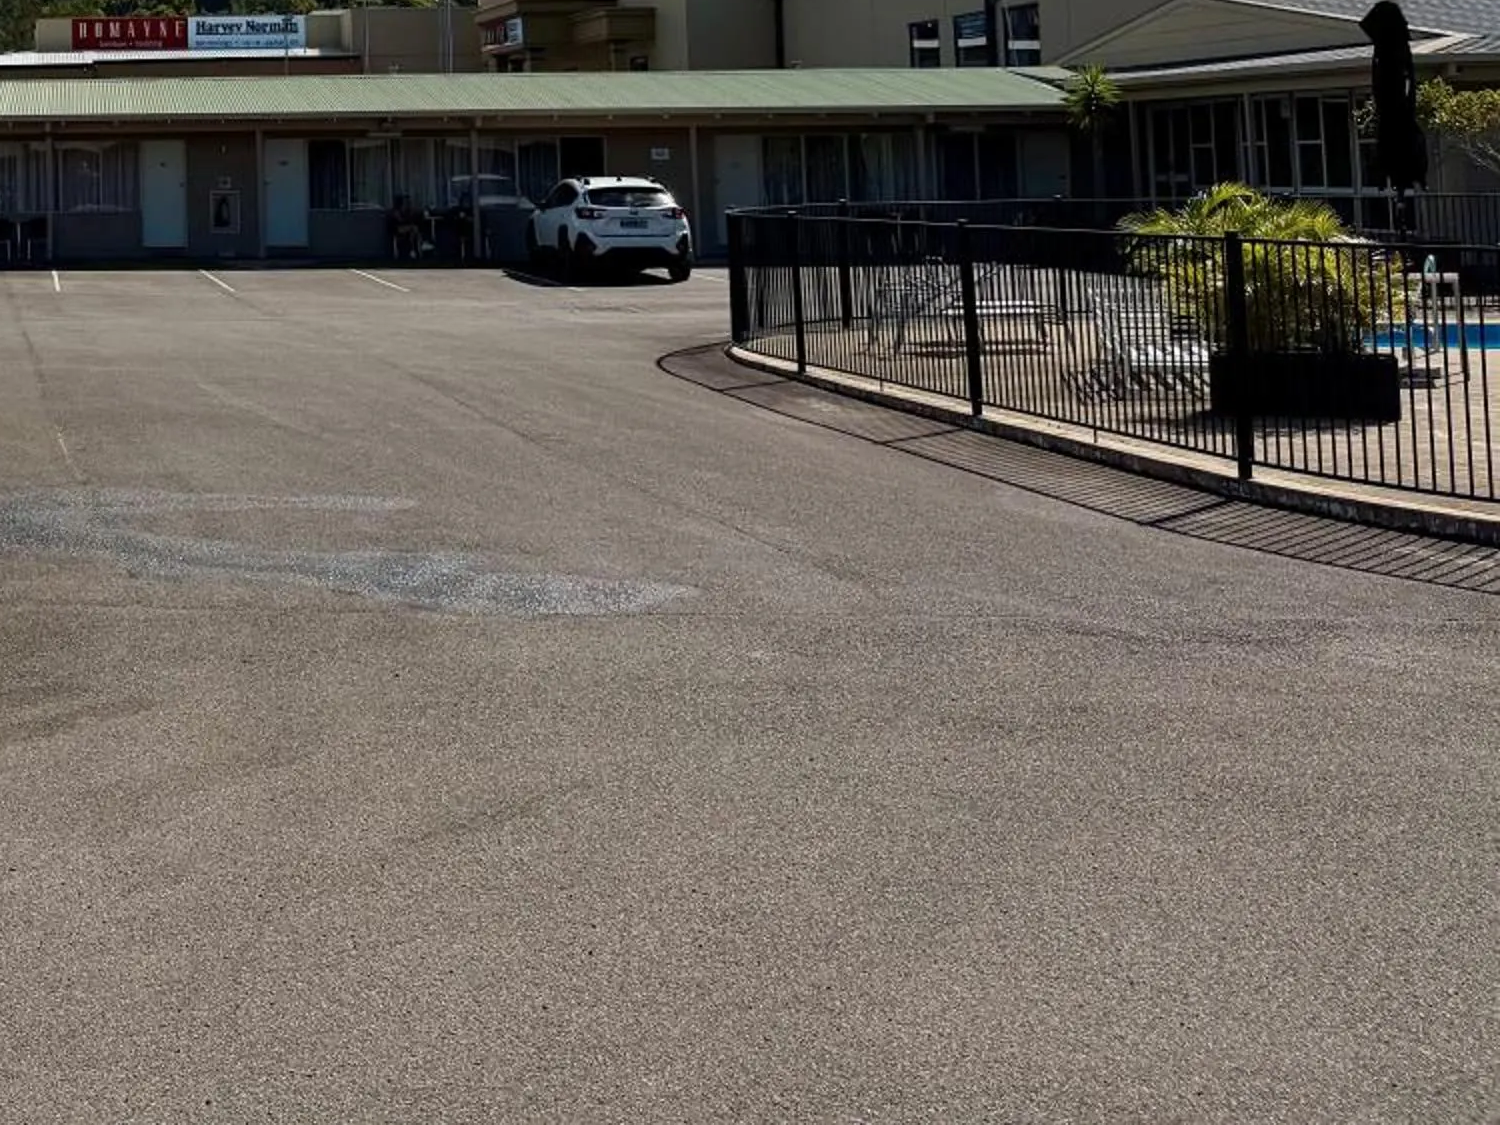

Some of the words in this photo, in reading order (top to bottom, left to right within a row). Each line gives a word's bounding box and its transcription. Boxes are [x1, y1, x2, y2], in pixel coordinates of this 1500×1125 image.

[79, 21, 185, 38] DOMAYNE
[196, 20, 242, 35] Harvey
[245, 19, 299, 34] Norman
